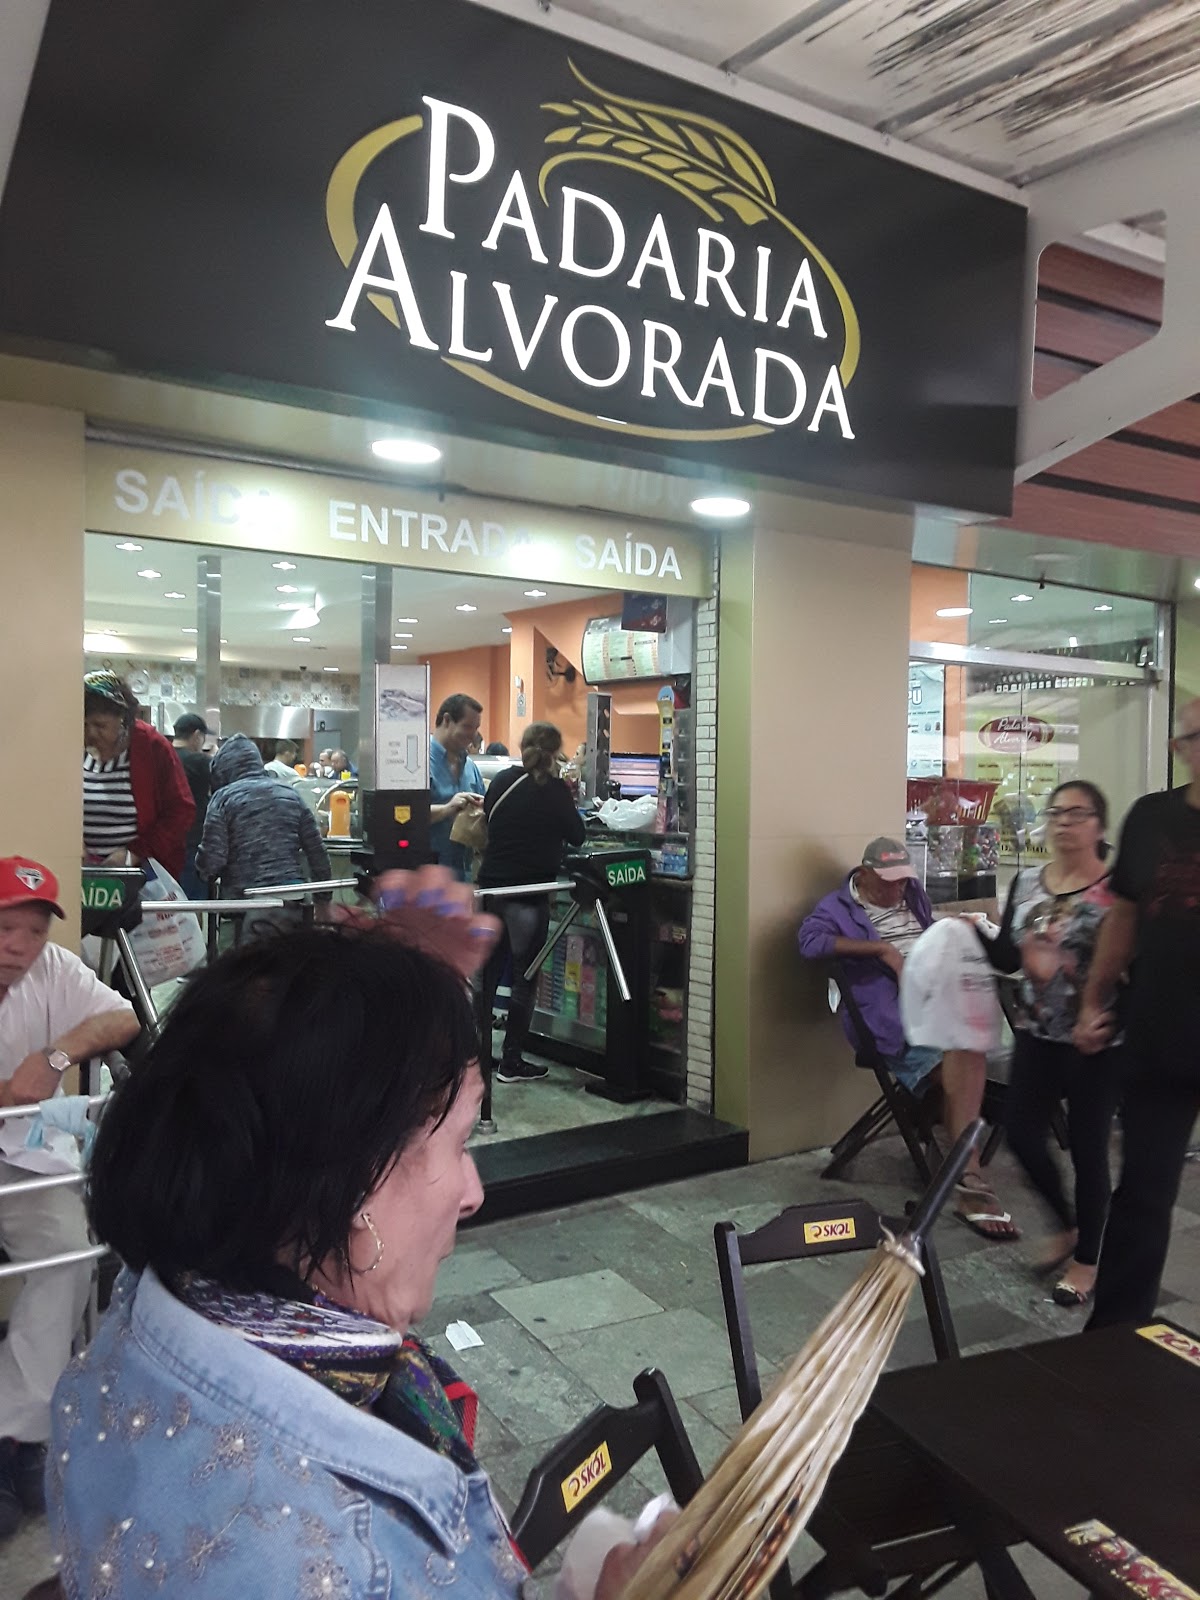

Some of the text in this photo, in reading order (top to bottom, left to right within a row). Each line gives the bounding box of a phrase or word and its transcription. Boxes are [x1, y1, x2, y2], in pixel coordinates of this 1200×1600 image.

[419, 95, 828, 339] PADARIA
[325, 203, 855, 440] ALVORADA
[114, 468, 281, 531] SAÍD
[575, 532, 683, 581] SAÍDA
[81, 882, 123, 907] AÍDA
[608, 864, 646, 886] SAÍDA
[823, 1222, 851, 1237] SKOL
[581, 1450, 607, 1489] SKOL
